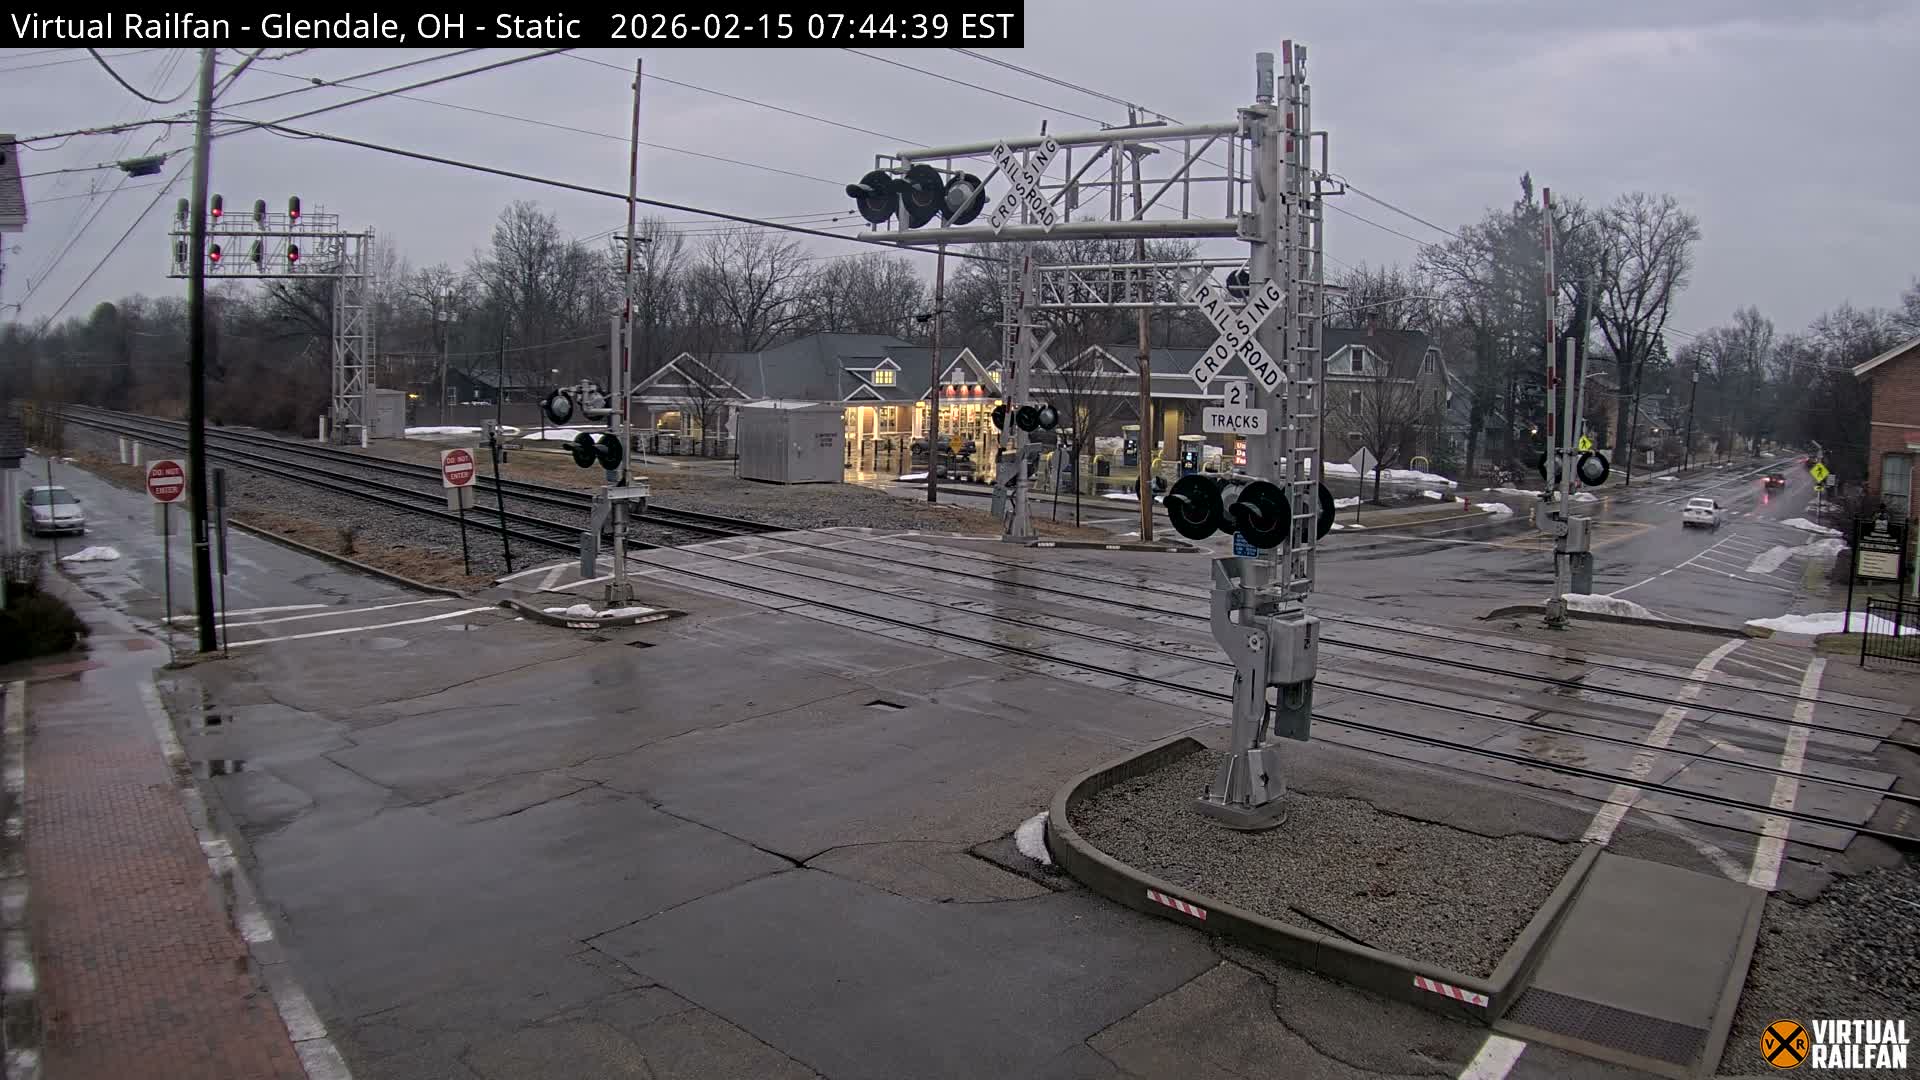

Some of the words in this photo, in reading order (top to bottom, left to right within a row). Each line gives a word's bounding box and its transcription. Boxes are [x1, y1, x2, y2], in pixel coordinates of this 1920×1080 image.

[991, 140, 1056, 229] CROSSING
[1195, 286, 1280, 383] CROSSING
[1211, 414, 1259, 429] TRACKS
[1230, 387, 1240, 404] 2
